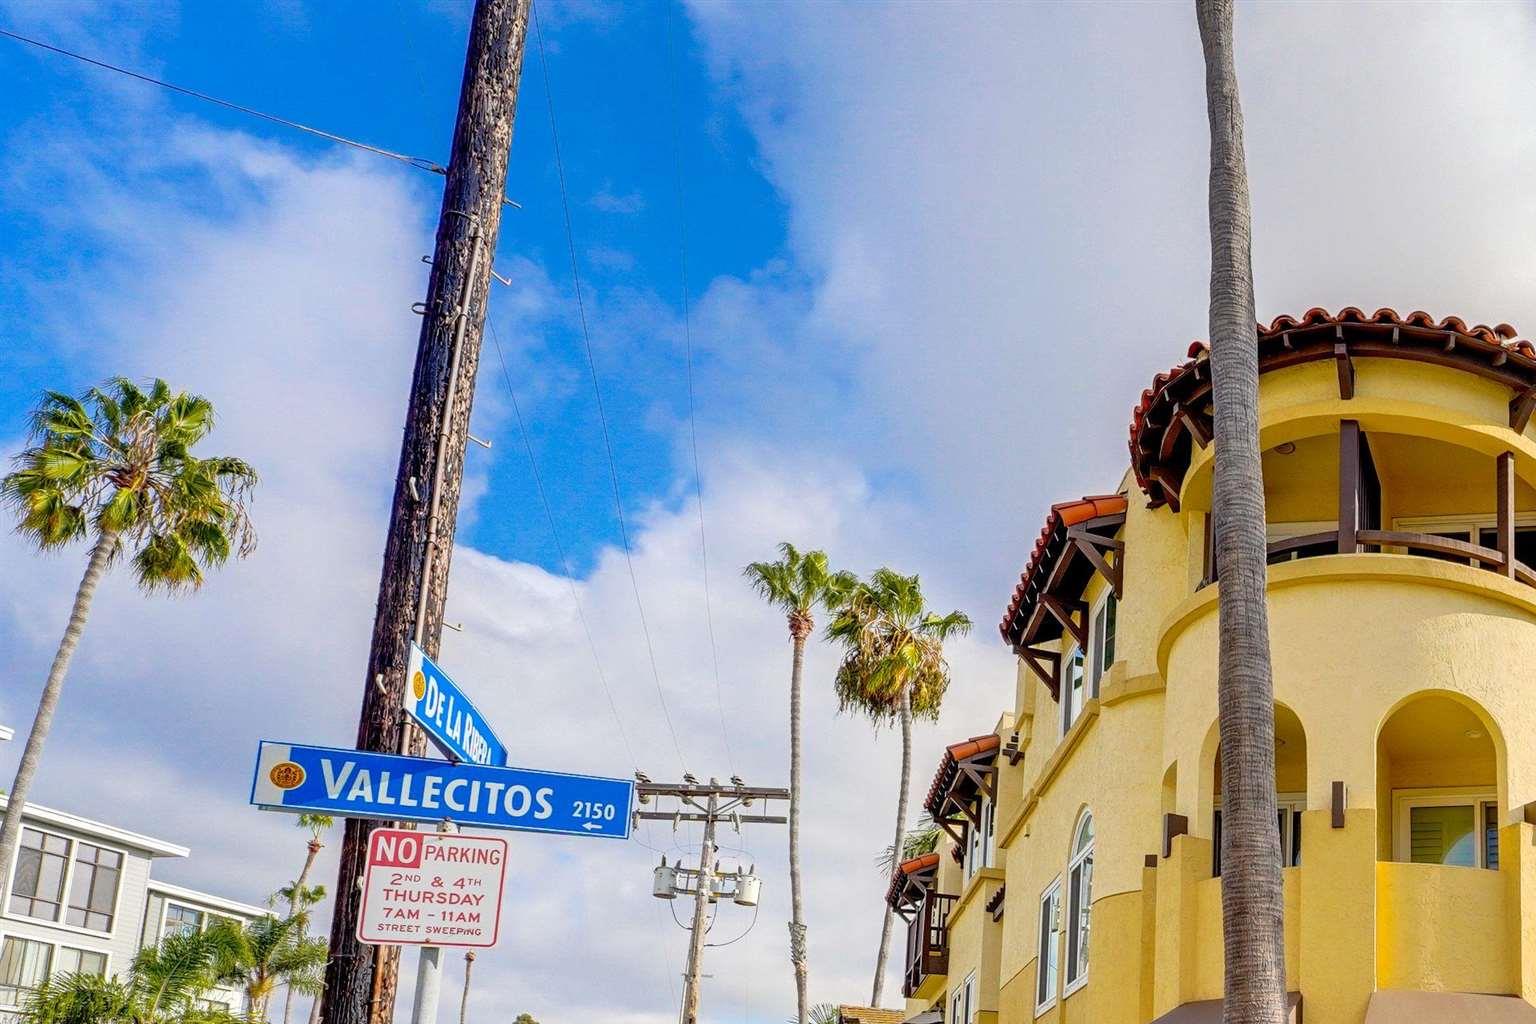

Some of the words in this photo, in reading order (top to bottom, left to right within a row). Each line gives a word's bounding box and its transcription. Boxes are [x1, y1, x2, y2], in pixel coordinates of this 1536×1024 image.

[425, 675, 446, 728] DE
[446, 695, 462, 744] LA
[320, 758, 554, 820] VALLECITOS
[572, 801, 615, 821] 2150
[376, 836, 418, 864] NO
[424, 845, 501, 865] PARKING
[390, 873, 421, 886] 2ND
[431, 876, 444, 888] &
[453, 877, 482, 889] 4TH
[383, 888, 485, 906] THURSDAY
[383, 907, 420, 920] 7AM
[441, 911, 480, 923] 11AM
[377, 923, 421, 933] STREET
[425, 926, 482, 936] SWEEPING
